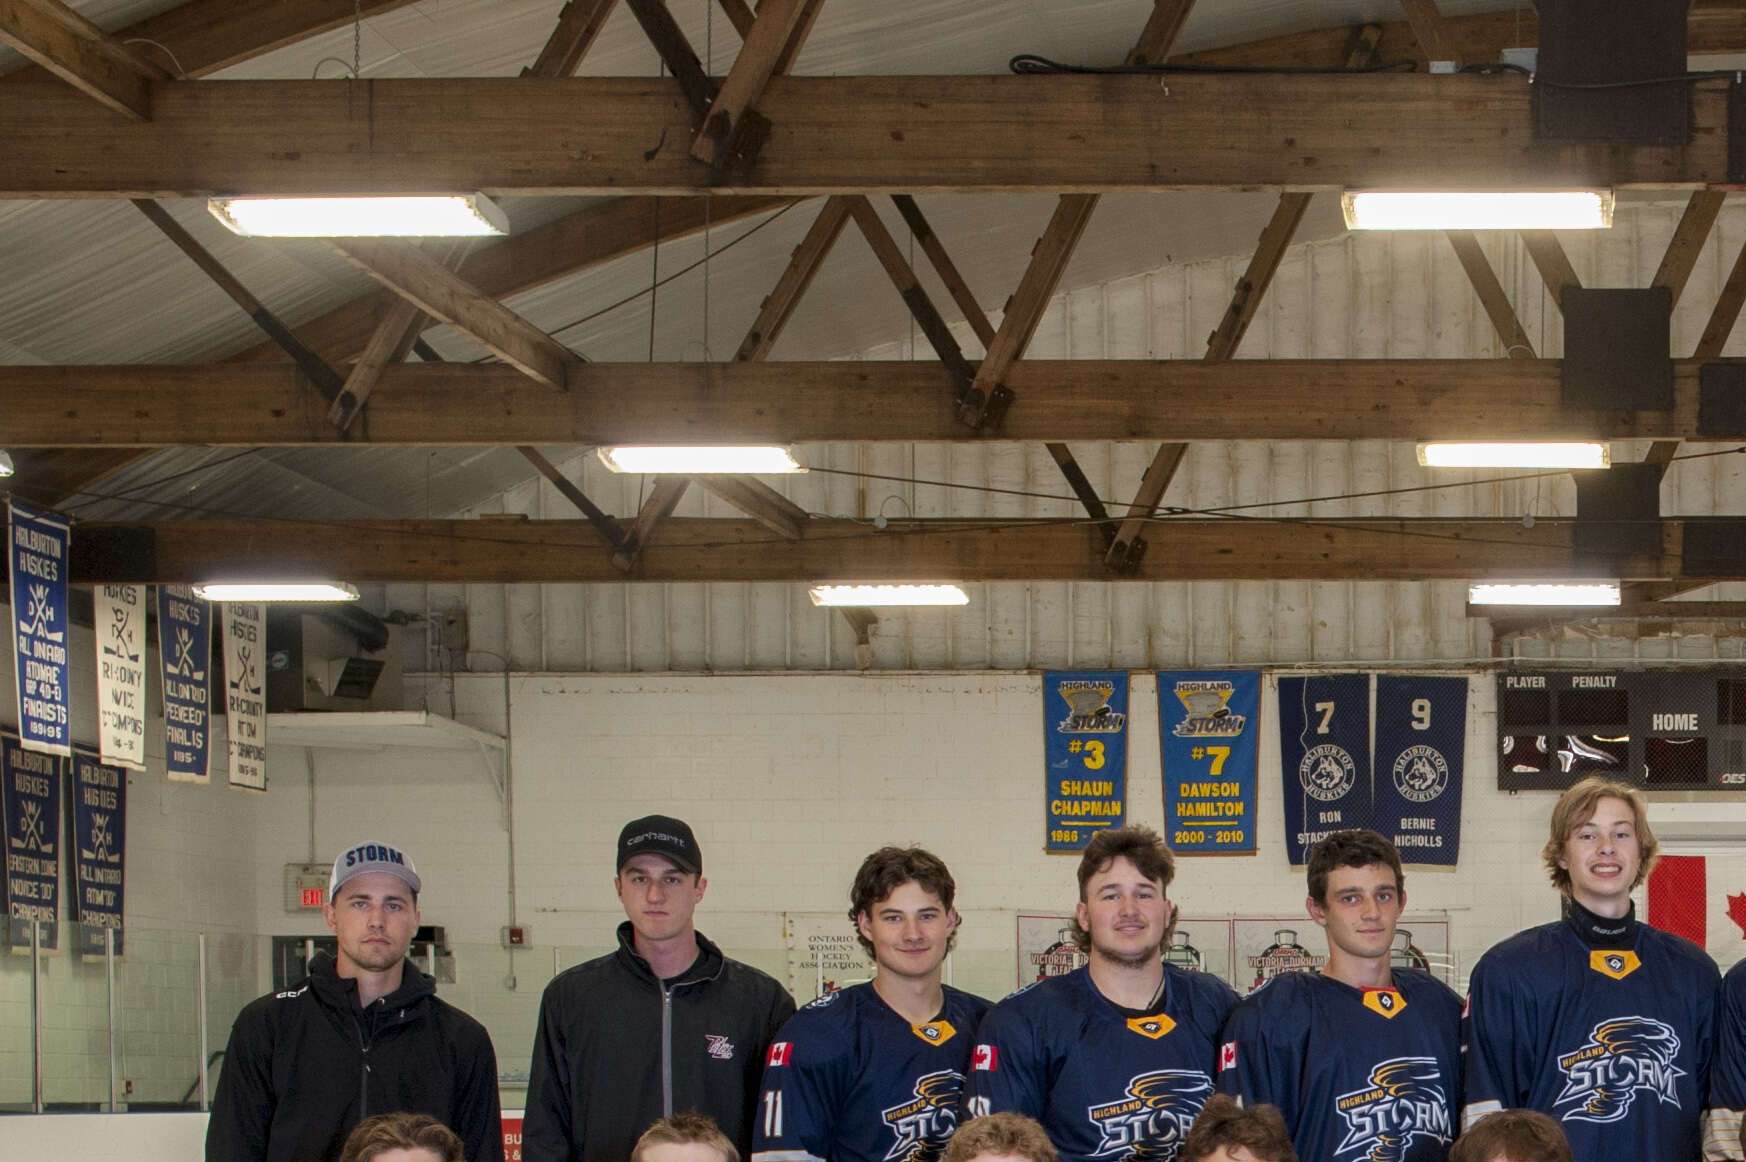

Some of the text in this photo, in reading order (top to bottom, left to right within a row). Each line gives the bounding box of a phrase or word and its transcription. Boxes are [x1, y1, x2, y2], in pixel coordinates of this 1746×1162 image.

[1062, 681, 1112, 690] HIGHLAND
[1177, 682, 1231, 691] HIGHLAND
[1506, 676, 1616, 688] PLAYER PENALTY
[1071, 714, 1121, 729] STORM
[1315, 701, 1335, 735] 7
[1411, 698, 1431, 731] 9
[1652, 713, 1698, 732] HOME
[1187, 716, 1240, 733] STORM
[1068, 739, 1106, 770] #3
[1191, 746, 1231, 776] #7
[1301, 744, 1353, 772] HALIBURTON
[1395, 745, 1448, 772] HALIBURTON
[1060, 780, 1113, 796] SHAUN
[1180, 783, 1240, 798] DAWSON
[1307, 782, 1351, 800] HUSKIES
[1400, 784, 1443, 801] HUSKIES
[1051, 800, 1121, 816] CHAPMAN
[1177, 801, 1244, 817] HAMILTON
[1319, 811, 1342, 824] RON
[1401, 818, 1436, 830] BERNIE
[627, 832, 686, 848] carhartt
[1175, 831, 1204, 844] 2000
[1216, 831, 1244, 844] 2010
[1394, 835, 1442, 848] NICHOLLS
[346, 845, 405, 867] STORM
[808, 935, 854, 943] ONTARIO
[1248, 956, 1325, 968] VICTORIA DURHAM
[1567, 1055, 1682, 1099] STORM
[1339, 1088, 1385, 1111] HIGHLAND
[763, 1090, 783, 1138] 11
[885, 1099, 927, 1123] HIGHLAND
[1092, 1099, 1143, 1121] HIGHLAND
[1347, 1097, 1454, 1140] STORM
[1100, 1108, 1198, 1150] STOR
